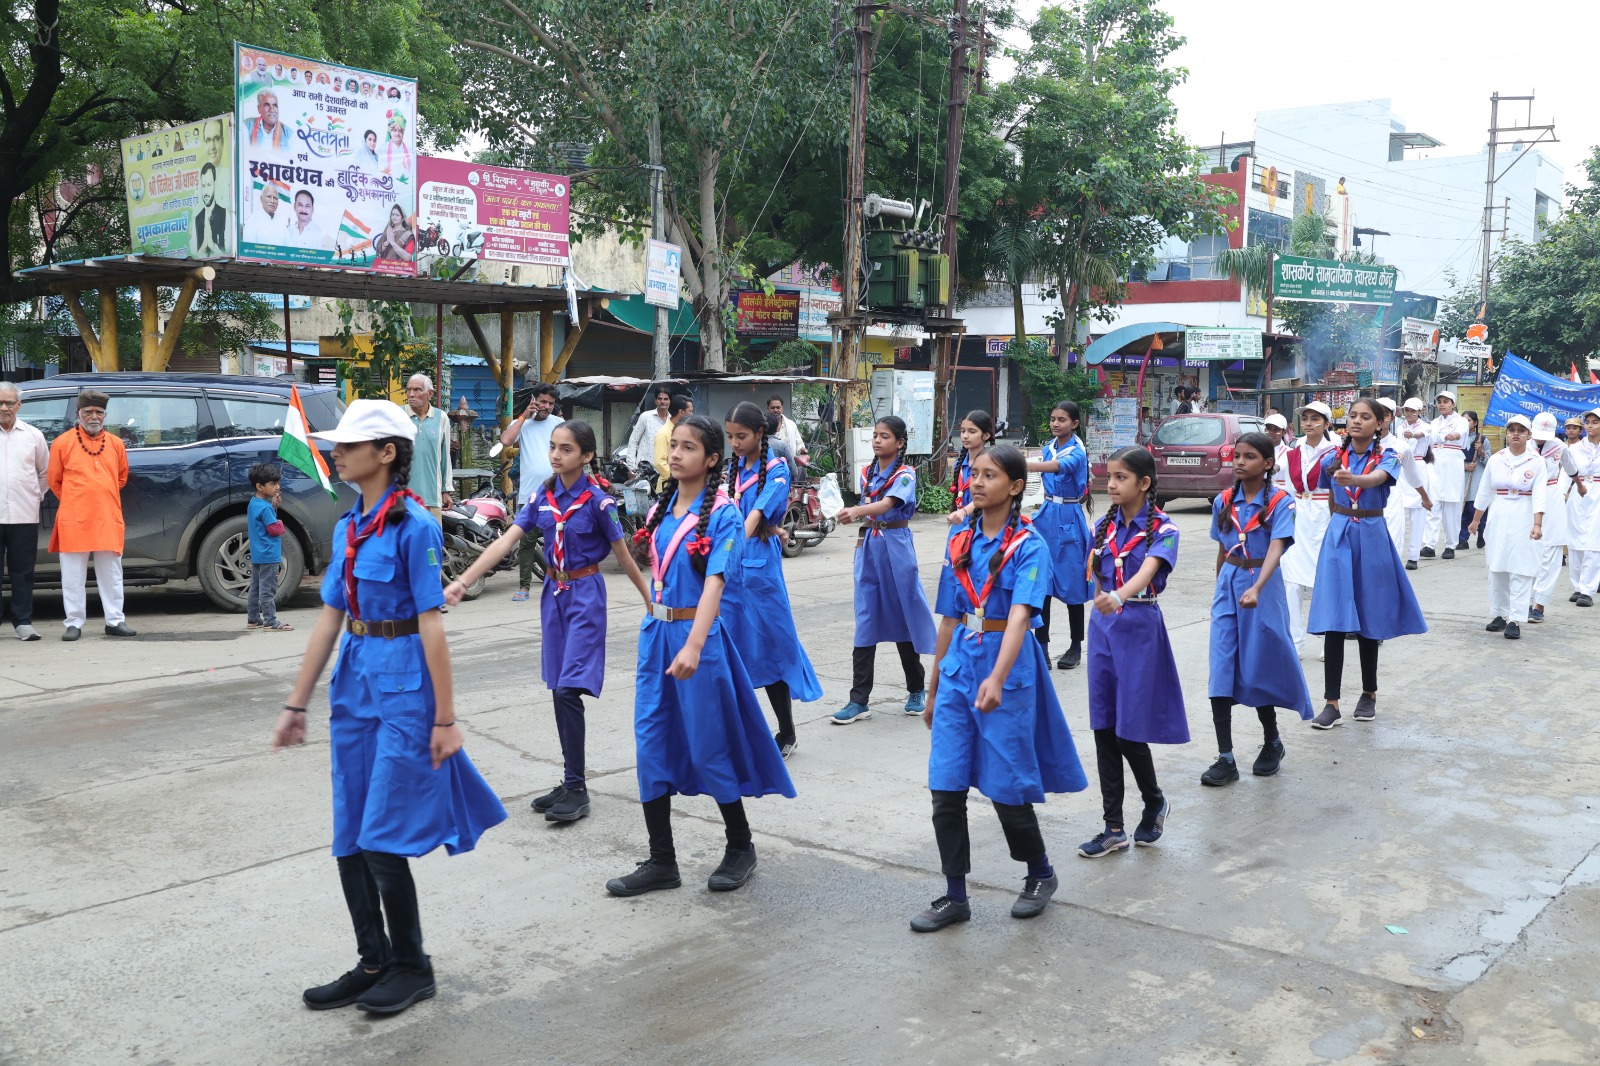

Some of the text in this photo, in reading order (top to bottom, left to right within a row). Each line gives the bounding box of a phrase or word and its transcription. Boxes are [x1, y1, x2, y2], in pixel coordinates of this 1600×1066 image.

[292, 89, 369, 110] आप सभी देशवासियों को
[315, 102, 347, 115] 15 अगस्त
[297, 153, 308, 162] एवं
[249, 159, 323, 187] रक्षाबंधन
[325, 178, 335, 188] की
[482, 171, 491, 182] श्री
[1281, 260, 1395, 288] शासकीय सामुदायिक स्वास्थ्य केन्द्र
[742, 295, 763, 307] सोलंकी
[755, 309, 770, 320] मोटर
